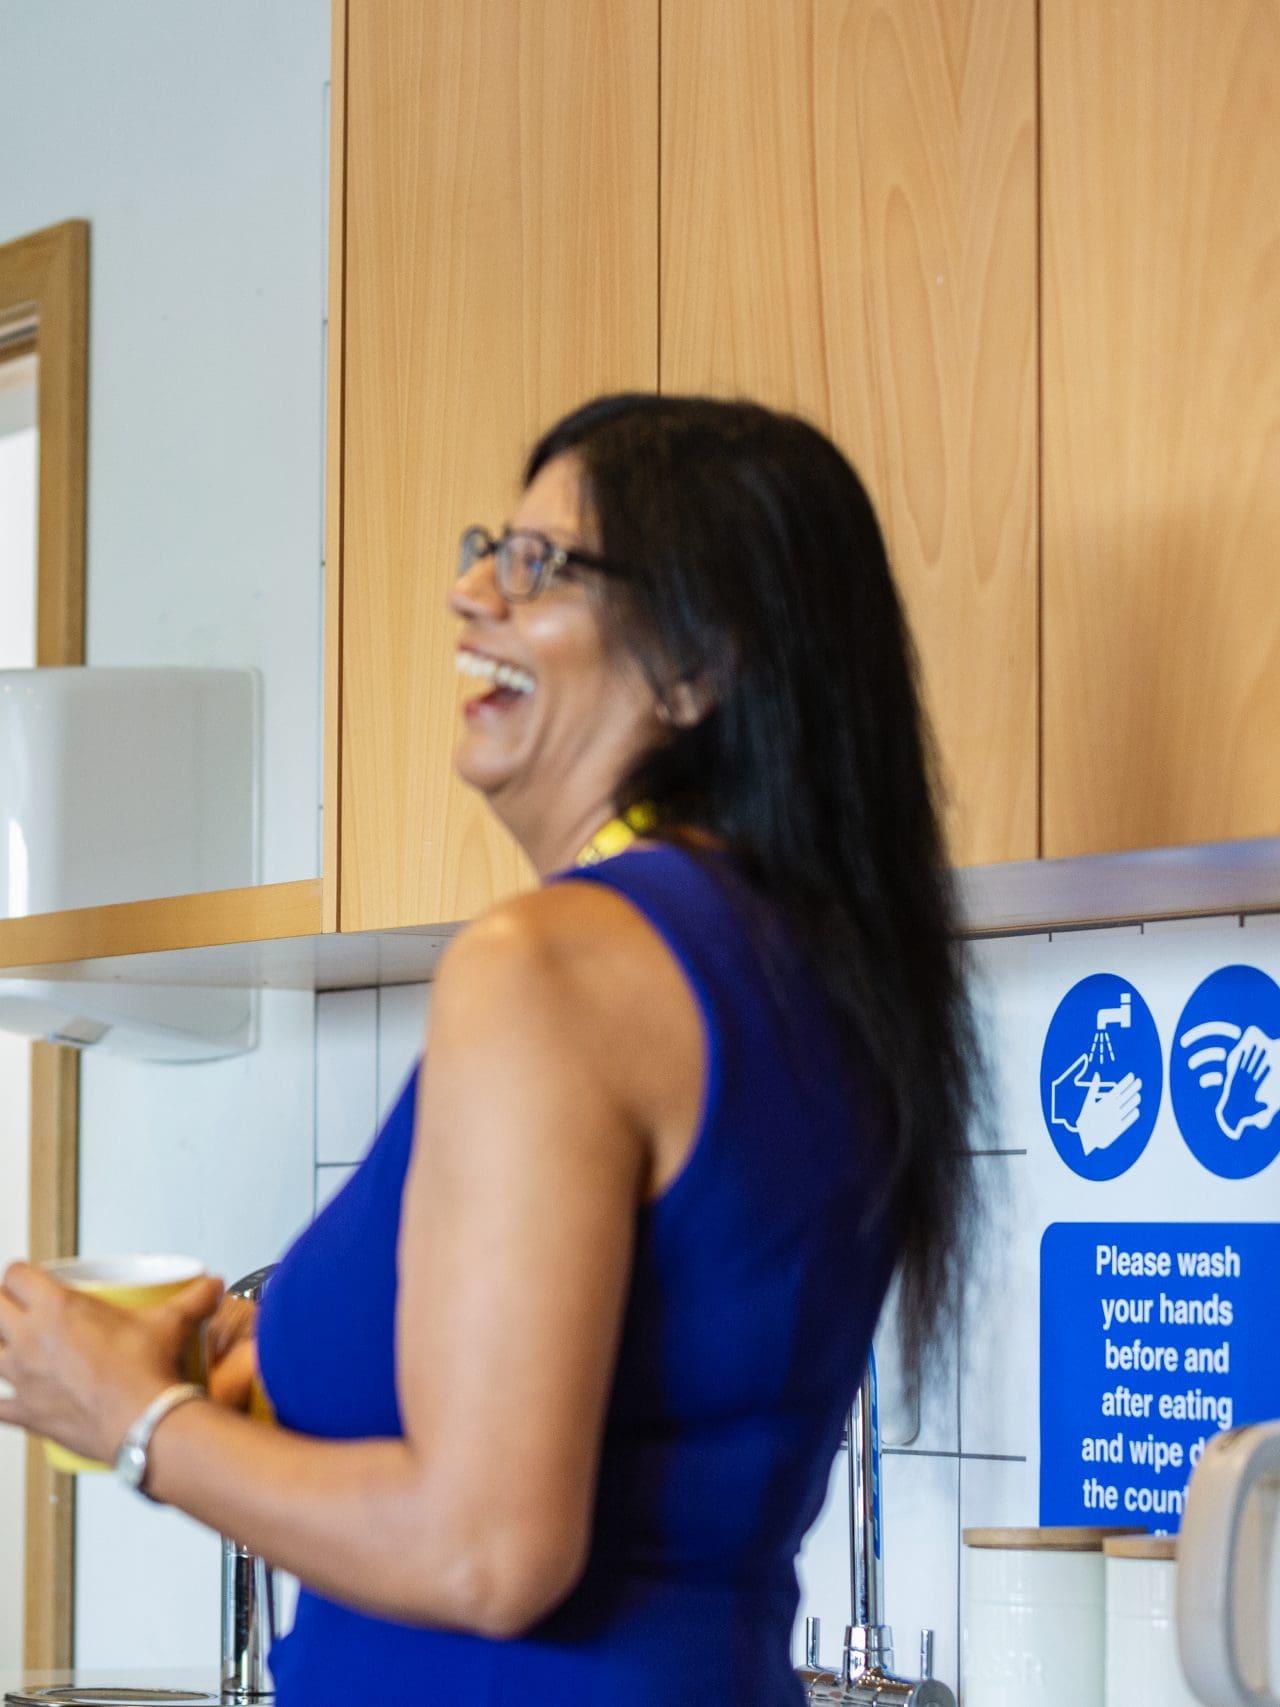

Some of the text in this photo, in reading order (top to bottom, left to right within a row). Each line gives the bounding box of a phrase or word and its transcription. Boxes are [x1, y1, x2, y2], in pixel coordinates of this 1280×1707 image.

[1096, 1244, 1241, 1278] Please wash
[1101, 1292, 1233, 1330] your hands
[1105, 1338, 1229, 1374] before and
[1101, 1385, 1233, 1430] after eating
[1081, 1432, 1123, 1463] and
[1129, 1433, 1184, 1474] wipe
[1082, 1477, 1119, 1510] the
